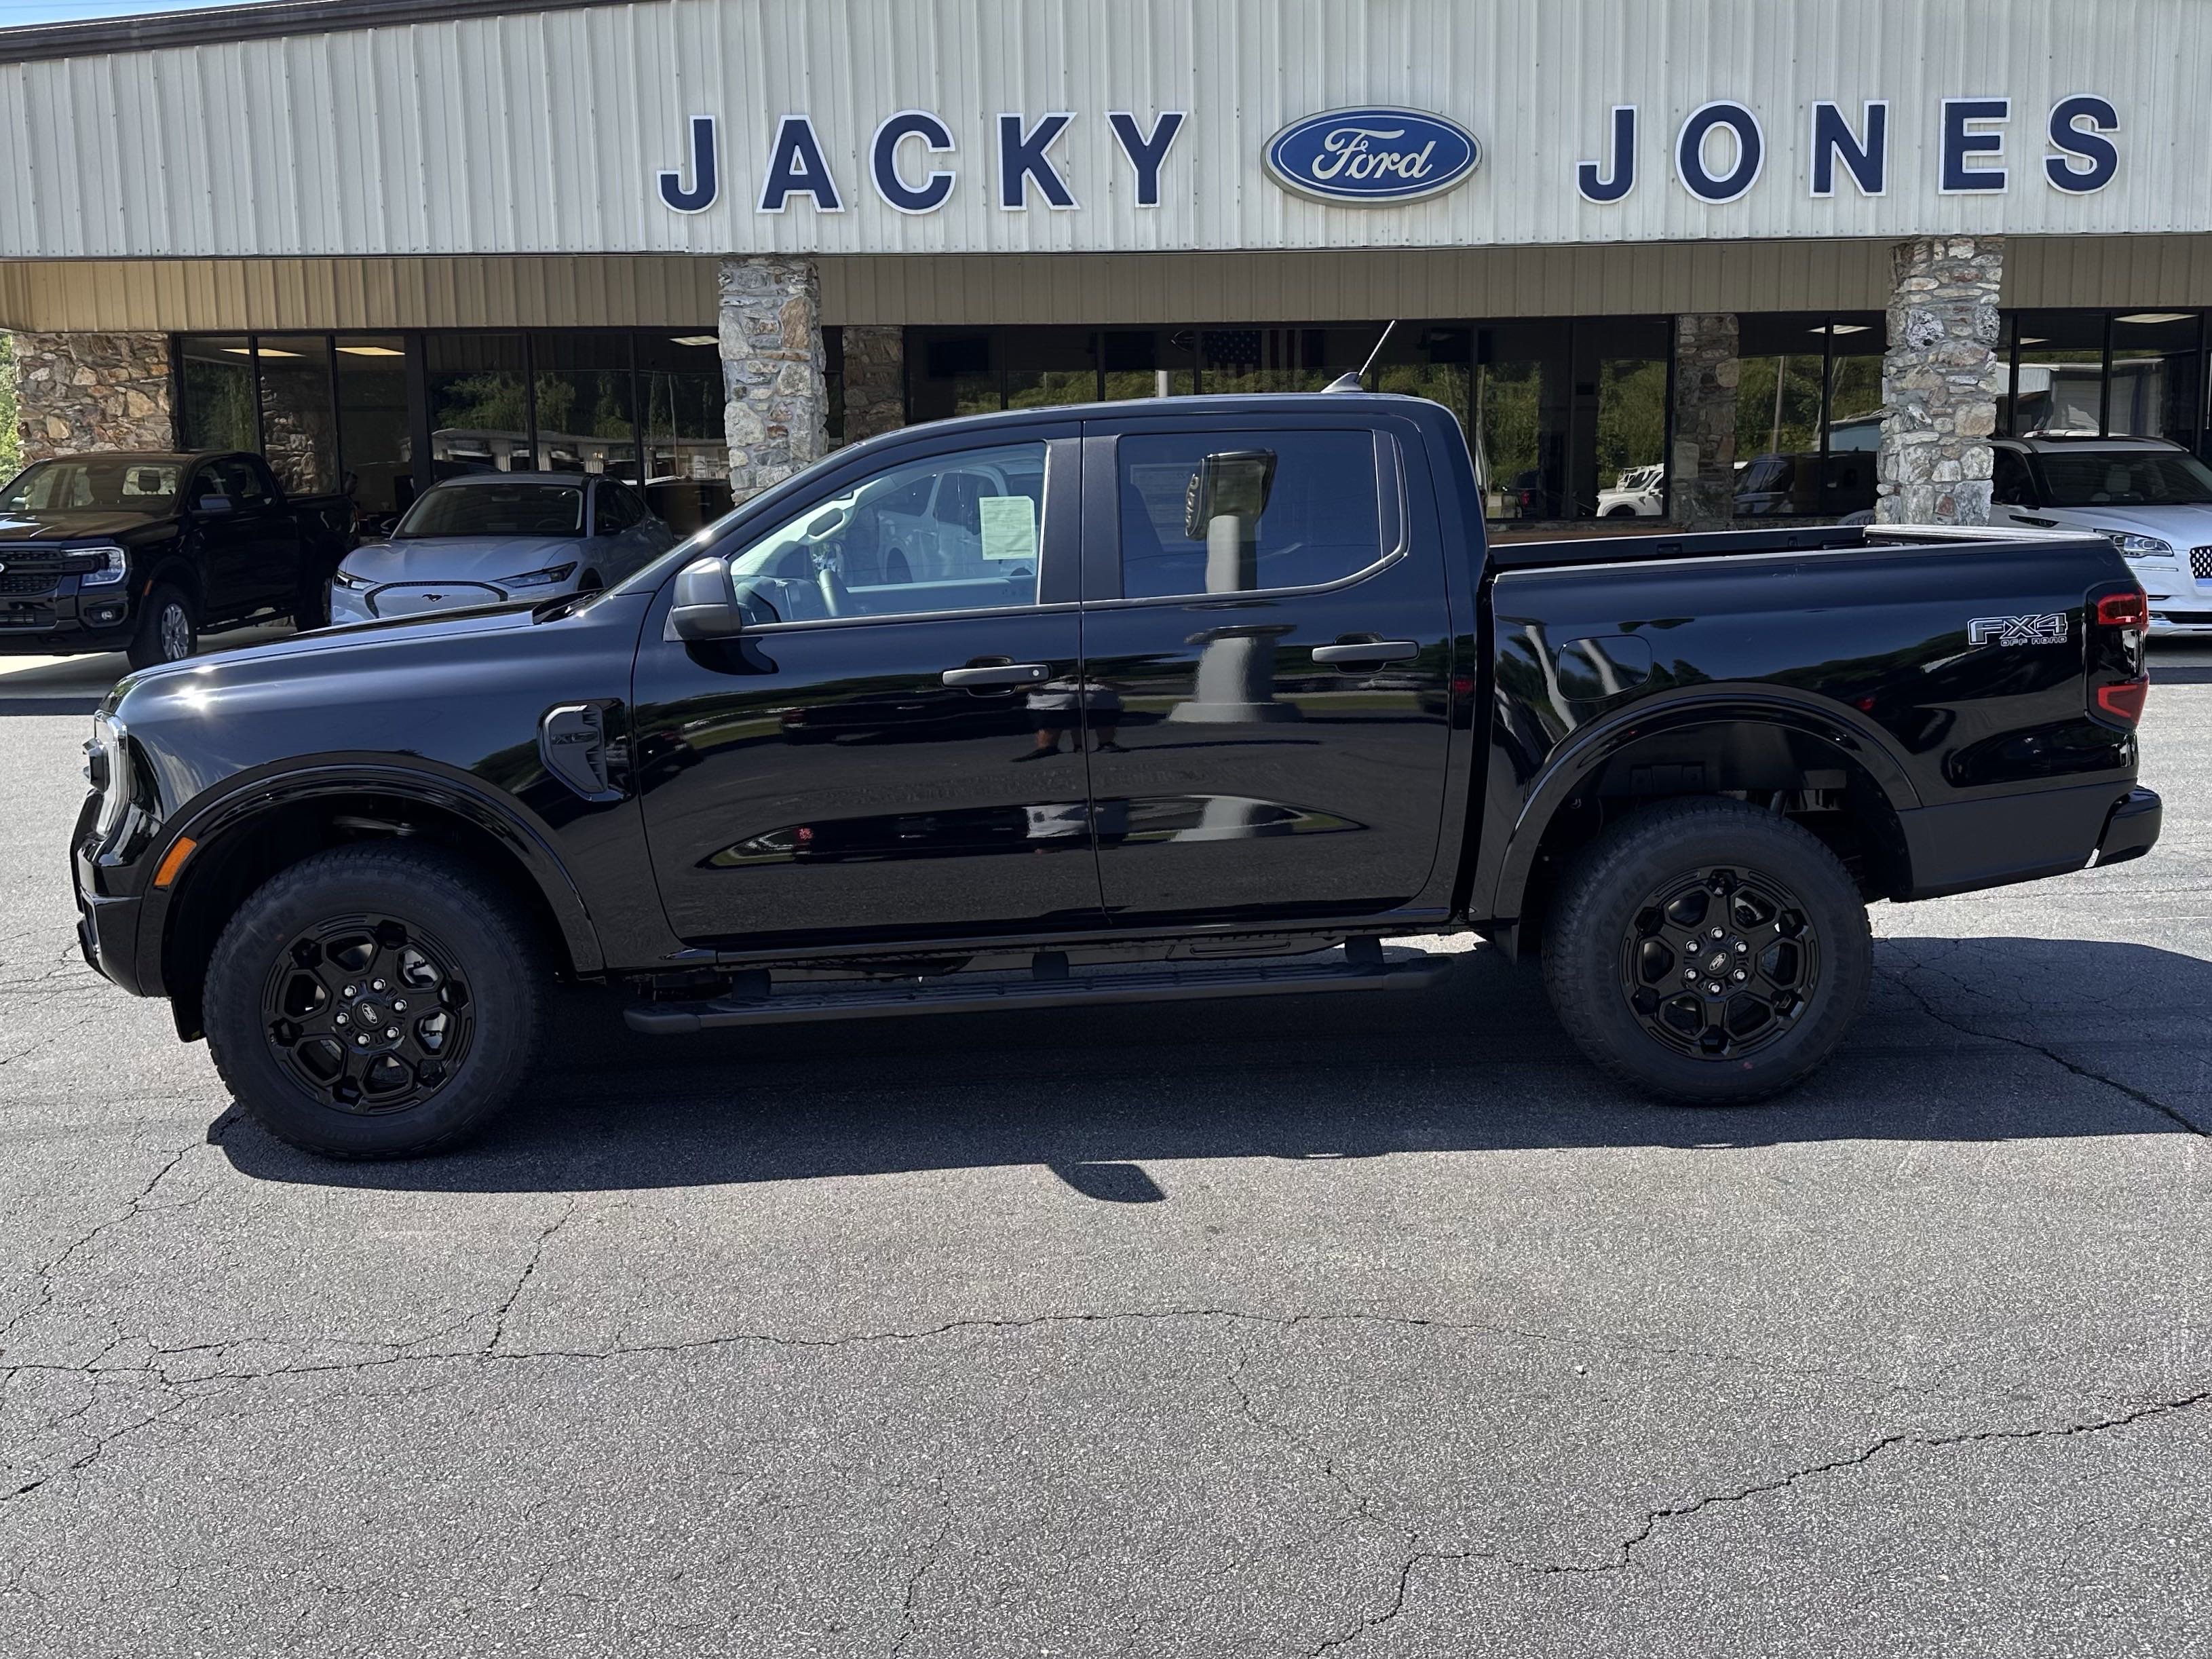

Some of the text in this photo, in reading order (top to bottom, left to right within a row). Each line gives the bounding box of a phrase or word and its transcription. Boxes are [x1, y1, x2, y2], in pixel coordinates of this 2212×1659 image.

[657, 110, 1187, 214] JACKY
[1312, 128, 1436, 179] Ford
[1577, 94, 2120, 207] JONES
[1967, 613, 2068, 645] FX4
[2001, 636, 2067, 647] OFF ROAD
